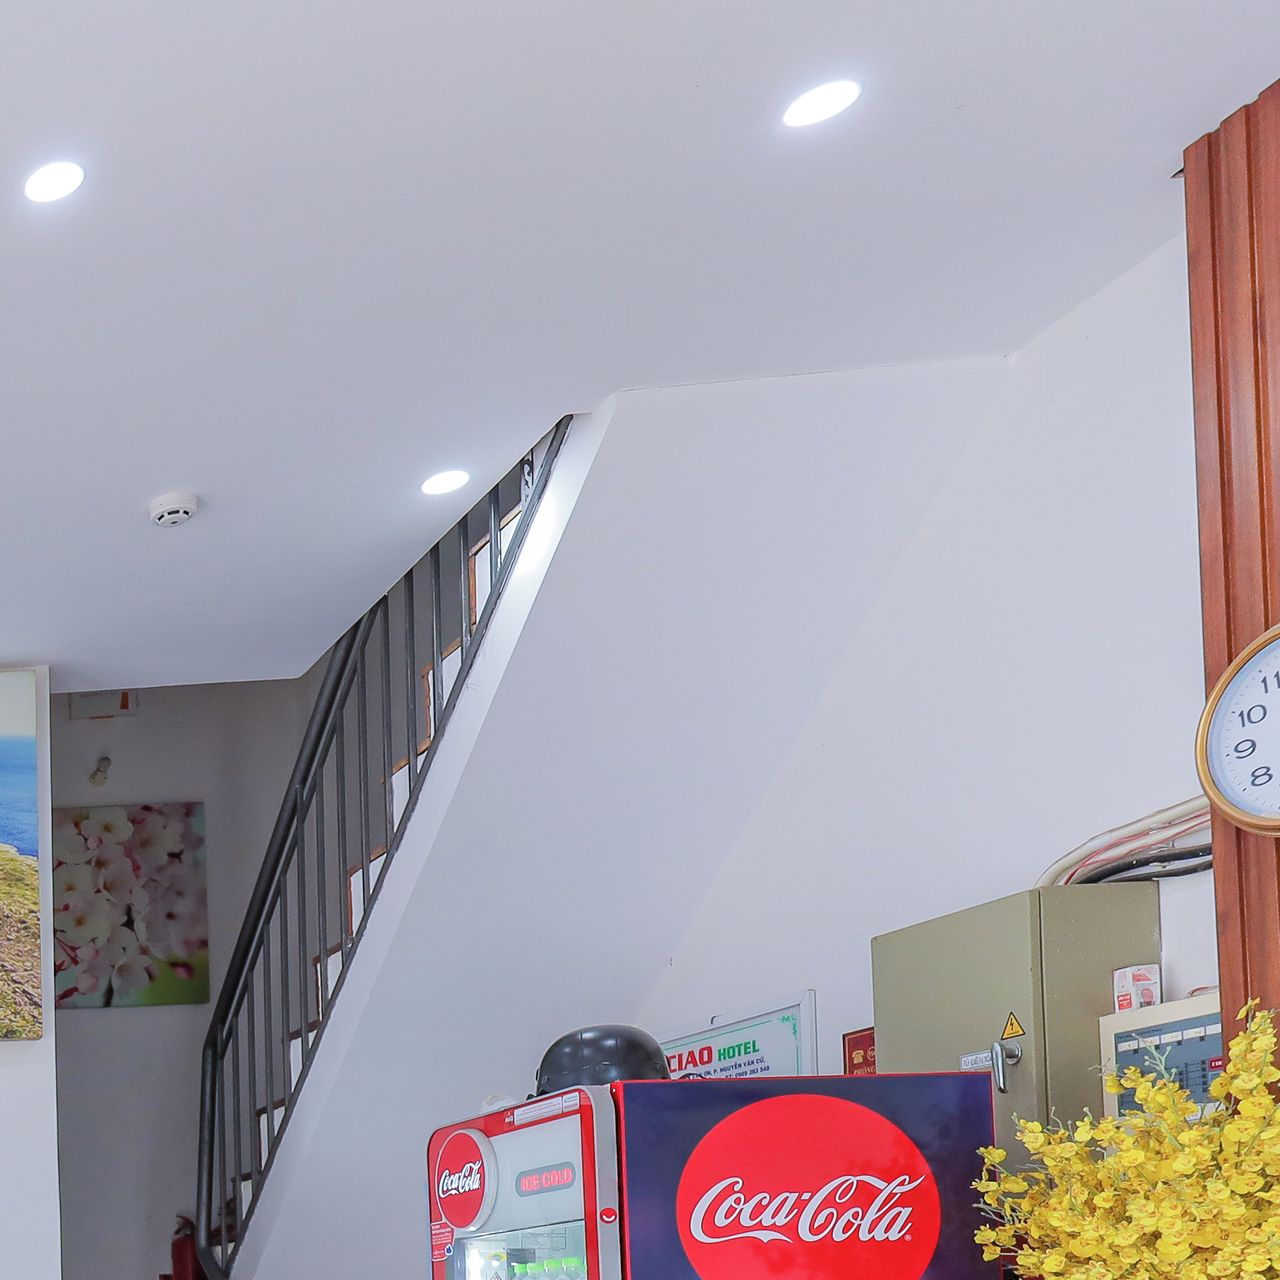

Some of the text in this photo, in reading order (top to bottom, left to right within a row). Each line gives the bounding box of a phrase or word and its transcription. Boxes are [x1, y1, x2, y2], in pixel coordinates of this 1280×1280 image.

[1238, 704, 1267, 728] 10
[1233, 739, 1256, 759] 9
[1250, 766, 1273, 786] 8
[667, 1039, 760, 1074] CIAO HOTEL
[439, 1159, 482, 1199] Coca-Cola
[521, 1168, 573, 1192] ICE COLD
[690, 1174, 926, 1244] Coca-Cola
